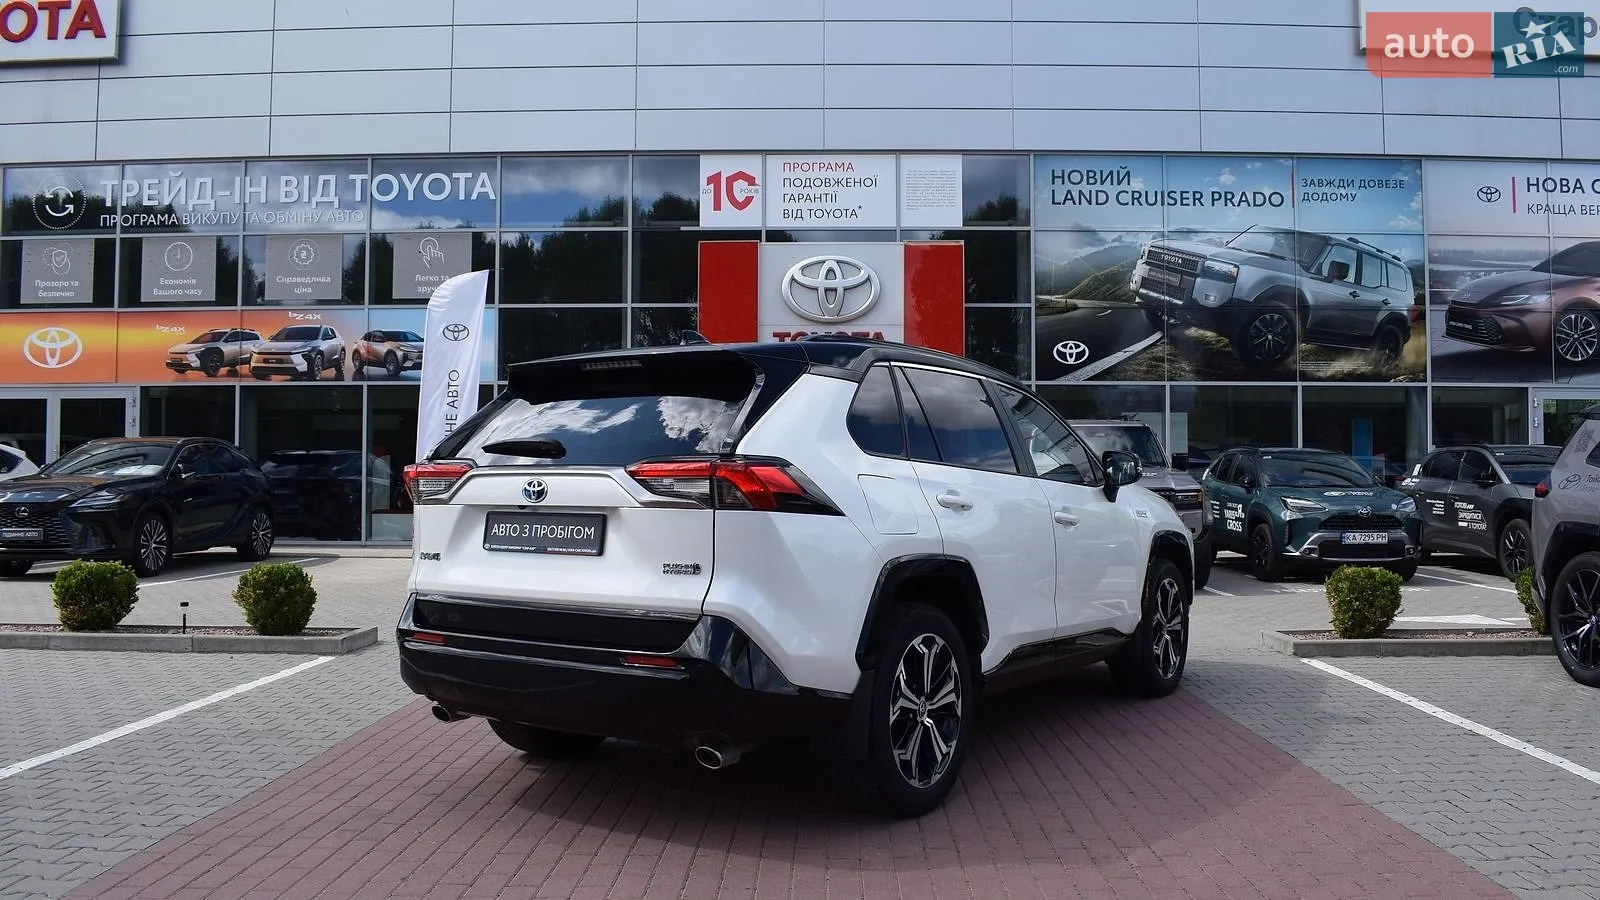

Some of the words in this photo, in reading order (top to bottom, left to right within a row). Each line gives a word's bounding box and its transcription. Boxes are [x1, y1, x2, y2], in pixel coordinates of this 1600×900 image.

[782, 162, 855, 173] ПРОГРАМА
[782, 174, 879, 190] ПОДОВЖЕНОЇ
[1051, 165, 1131, 186] НОВИЙ
[100, 170, 268, 211] ТРЕЙД-ІН
[279, 174, 340, 209] ВІД
[348, 172, 497, 202] TOYOTA
[1301, 178, 1355, 190] ЗАВЖДИ
[1358, 179, 1405, 190] ДОВЕЗЕ
[1526, 176, 1586, 194] НОВА
[782, 190, 839, 204] ГАРАНТІЇ
[1051, 189, 1110, 206] LAND
[1115, 190, 1204, 207] CRUISER
[1211, 191, 1285, 207] PRADO
[1301, 192, 1358, 203] ДОДОМУ
[782, 208, 804, 221] ВІД
[1527, 203, 1577, 217] КРАЩА
[100, 213, 179, 227] ПРОГРАМА
[182, 211, 240, 226] ВИКУПУ
[243, 211, 261, 225] ТА
[263, 210, 323, 225] ОБМІНУ
[326, 209, 365, 223] АВТО
[1161, 254, 1182, 264] TOYOTA
[276, 275, 332, 284] Справедлива
[153, 288, 183, 296] Вашого
[446, 369, 460, 409] АВТО
[491, 523, 520, 537] АВТО
[521, 524, 530, 537] З
[532, 524, 595, 540] ПРОБІГОМ
[1359, 533, 1375, 542] 7295
